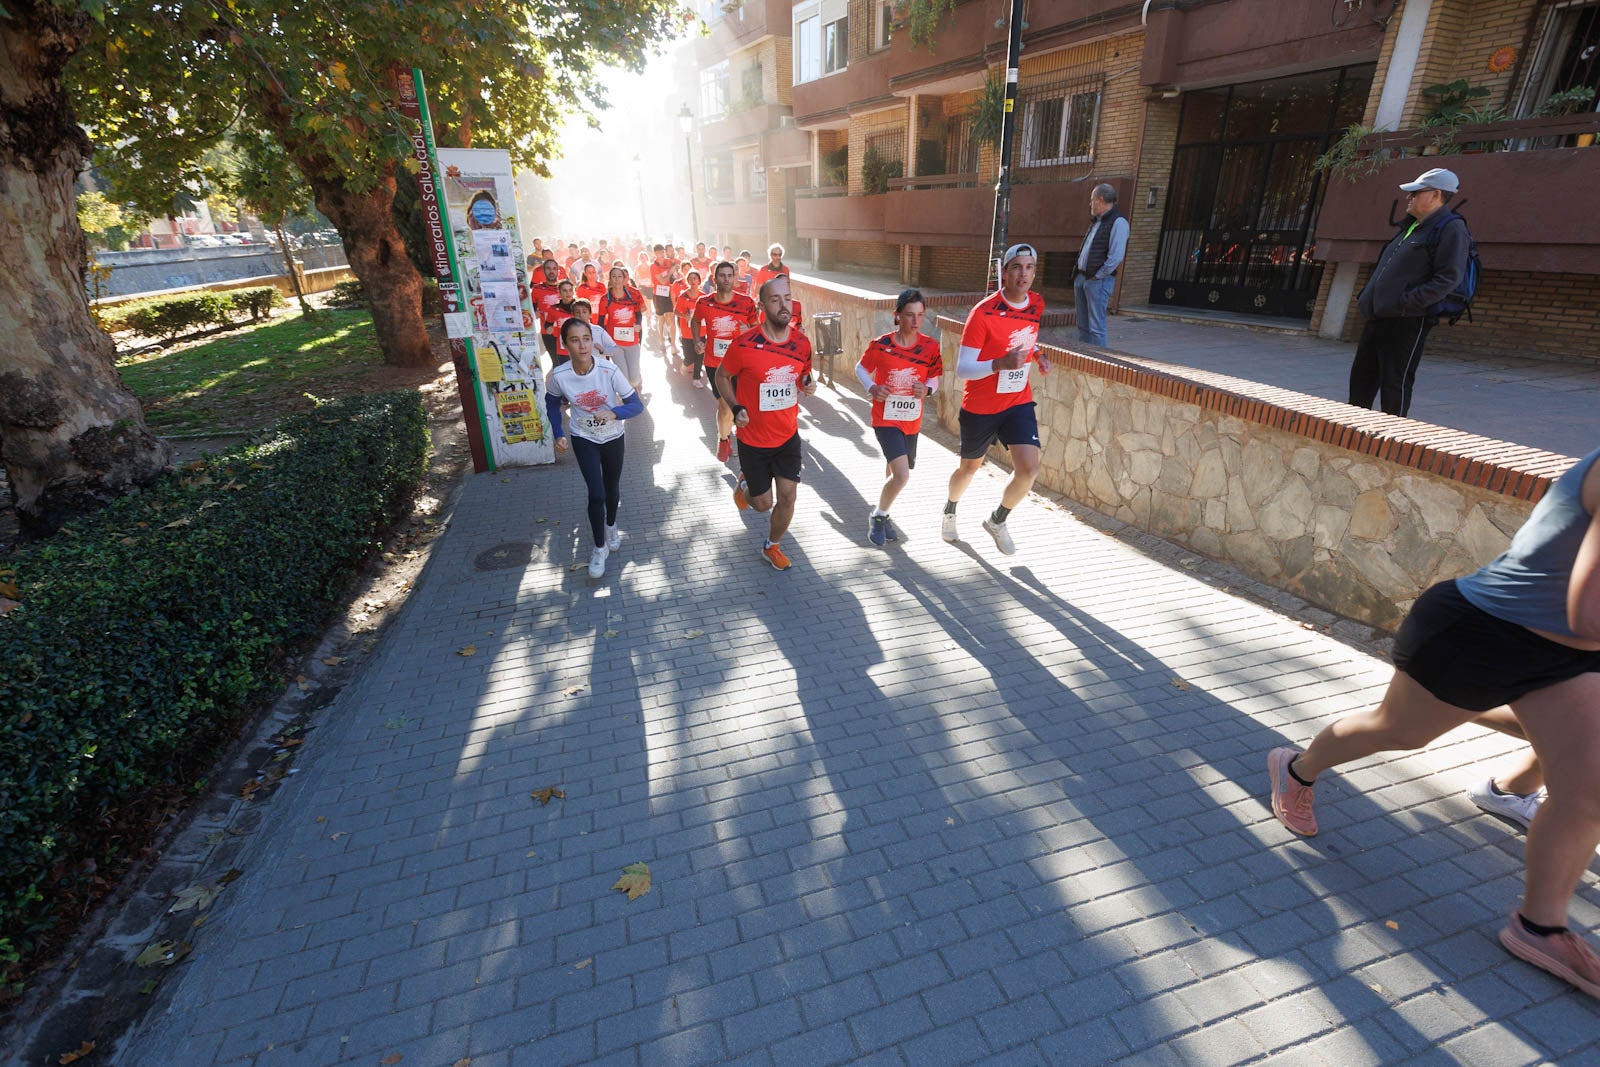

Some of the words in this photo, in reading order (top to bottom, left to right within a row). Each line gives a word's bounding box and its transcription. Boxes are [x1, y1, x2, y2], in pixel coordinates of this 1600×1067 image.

[1269, 118, 1280, 133] 2
[426, 205, 450, 273] tinerarios
[1008, 370, 1024, 380] 999
[766, 388, 791, 398] 1016
[891, 401, 916, 410] 1000
[586, 418, 607, 428] 352
